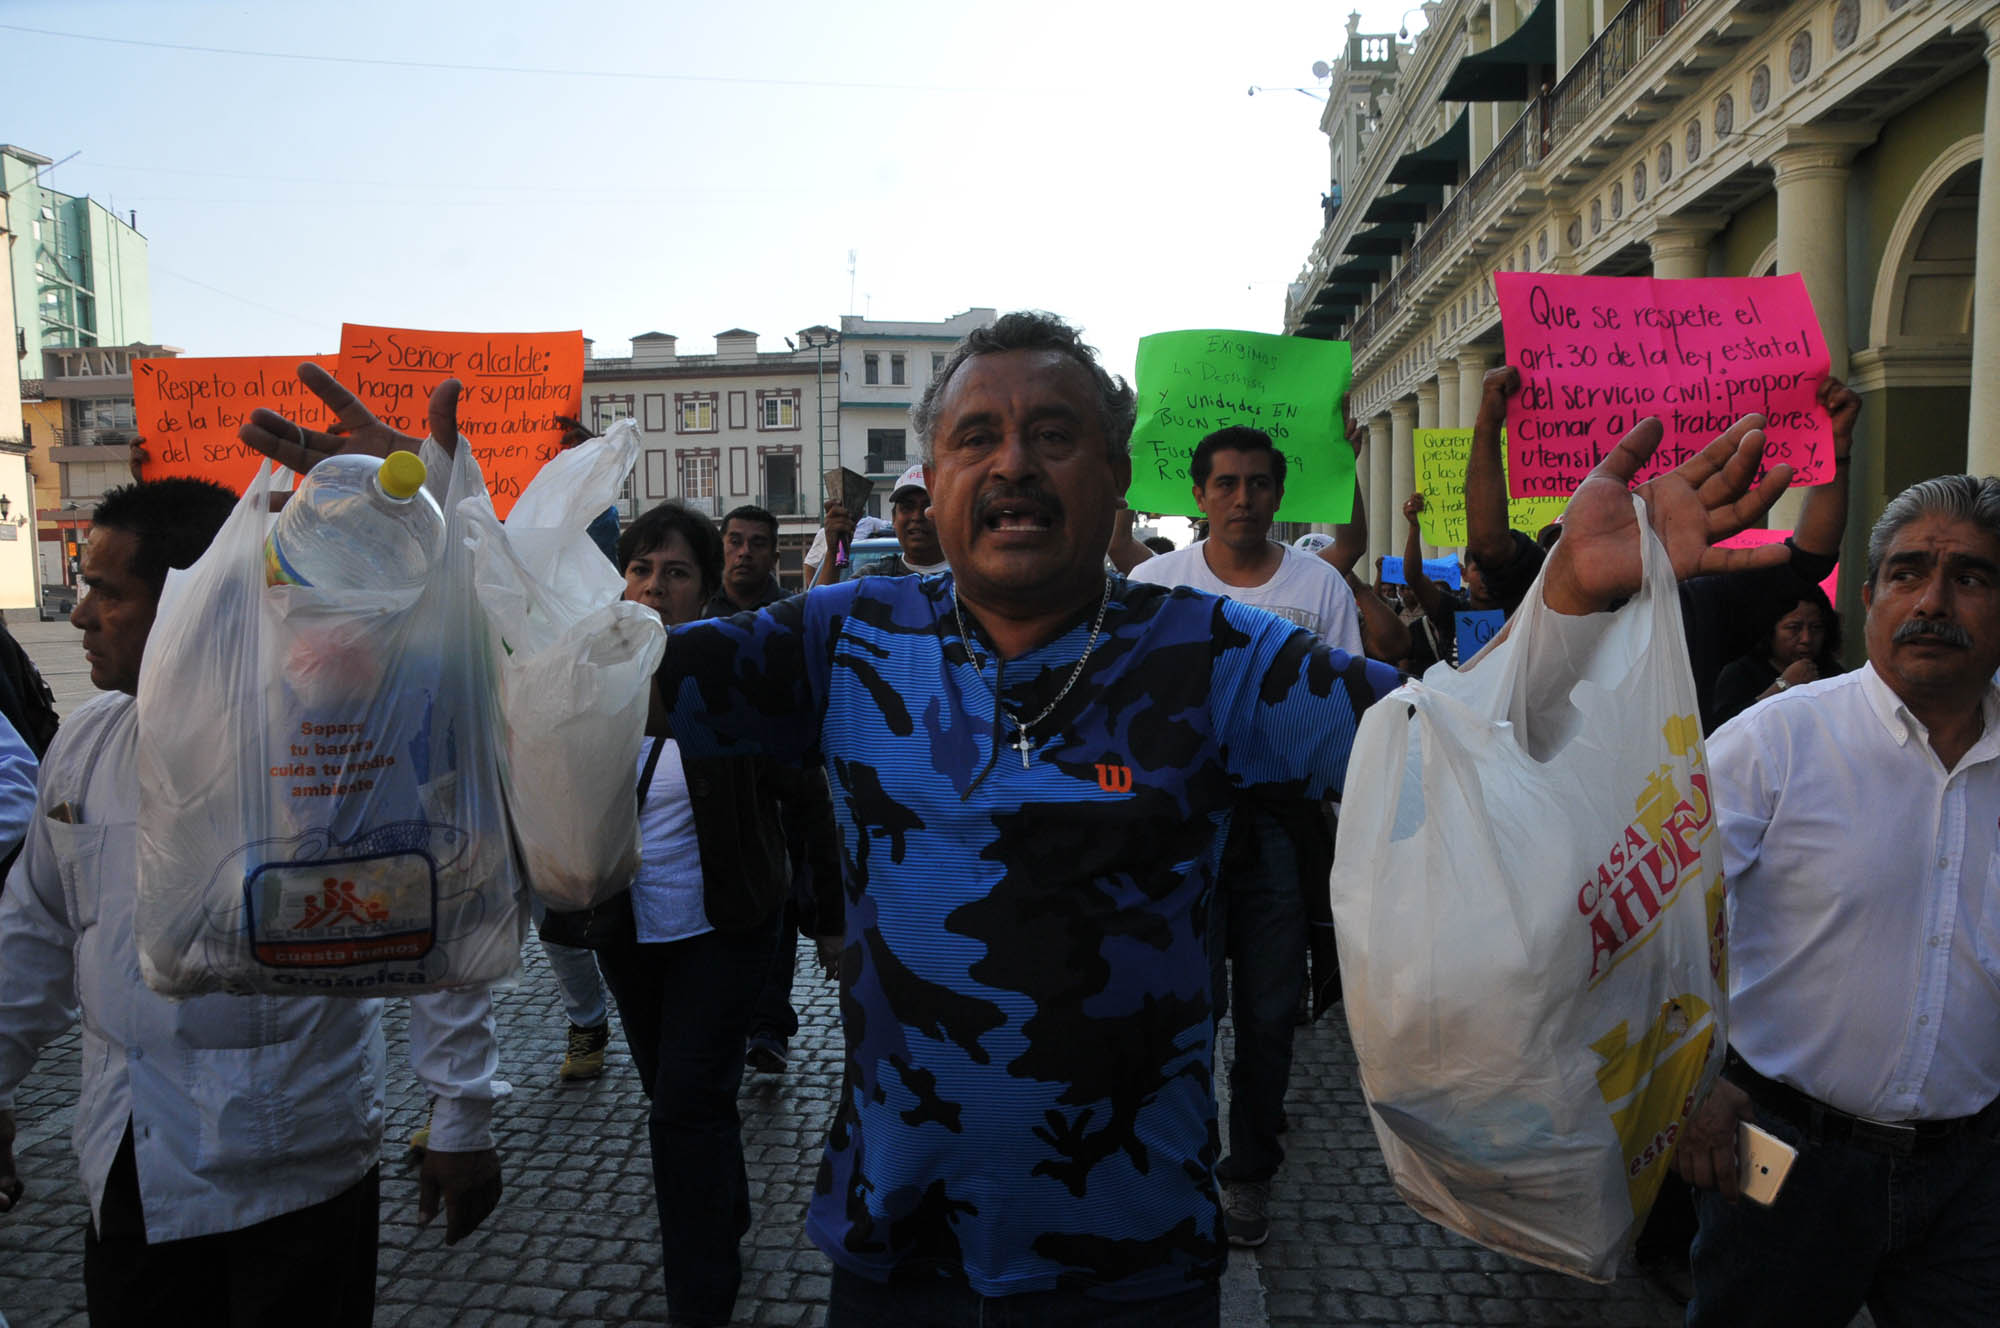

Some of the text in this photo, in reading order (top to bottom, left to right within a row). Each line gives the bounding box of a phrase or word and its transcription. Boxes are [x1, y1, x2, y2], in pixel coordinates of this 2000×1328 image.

[1529, 285, 1761, 346] Que se respete el
[388, 334, 552, 373] Señor alcalde:
[1520, 329, 1812, 375] art. 30 de la ley estatal
[243, 369, 265, 397] al
[357, 372, 414, 413] haga
[423, 383, 476, 402] ver
[480, 382, 502, 404] su
[504, 376, 572, 413] palabra
[1521, 376, 1553, 410] del
[1561, 382, 1656, 411] servicio
[156, 410, 182, 433] de
[187, 409, 208, 430] la
[217, 406, 245, 429] ley
[1272, 402, 1298, 419] EN
[1607, 415, 1624, 434] a
[1672, 406, 1820, 434] trabadores,
[161, 437, 261, 464] del servic
[1422, 470, 1432, 481] a
[1423, 482, 1440, 498] de
[290, 743, 309, 757] tu
[269, 762, 317, 777] cuida
[322, 762, 343, 776] tu
[291, 778, 374, 797] ambiente
[1577, 823, 1649, 916] CASA
[1588, 772, 1712, 983] AHUED
[274, 943, 419, 962] cuesta menos
[1630, 1124, 1680, 1177] esta
